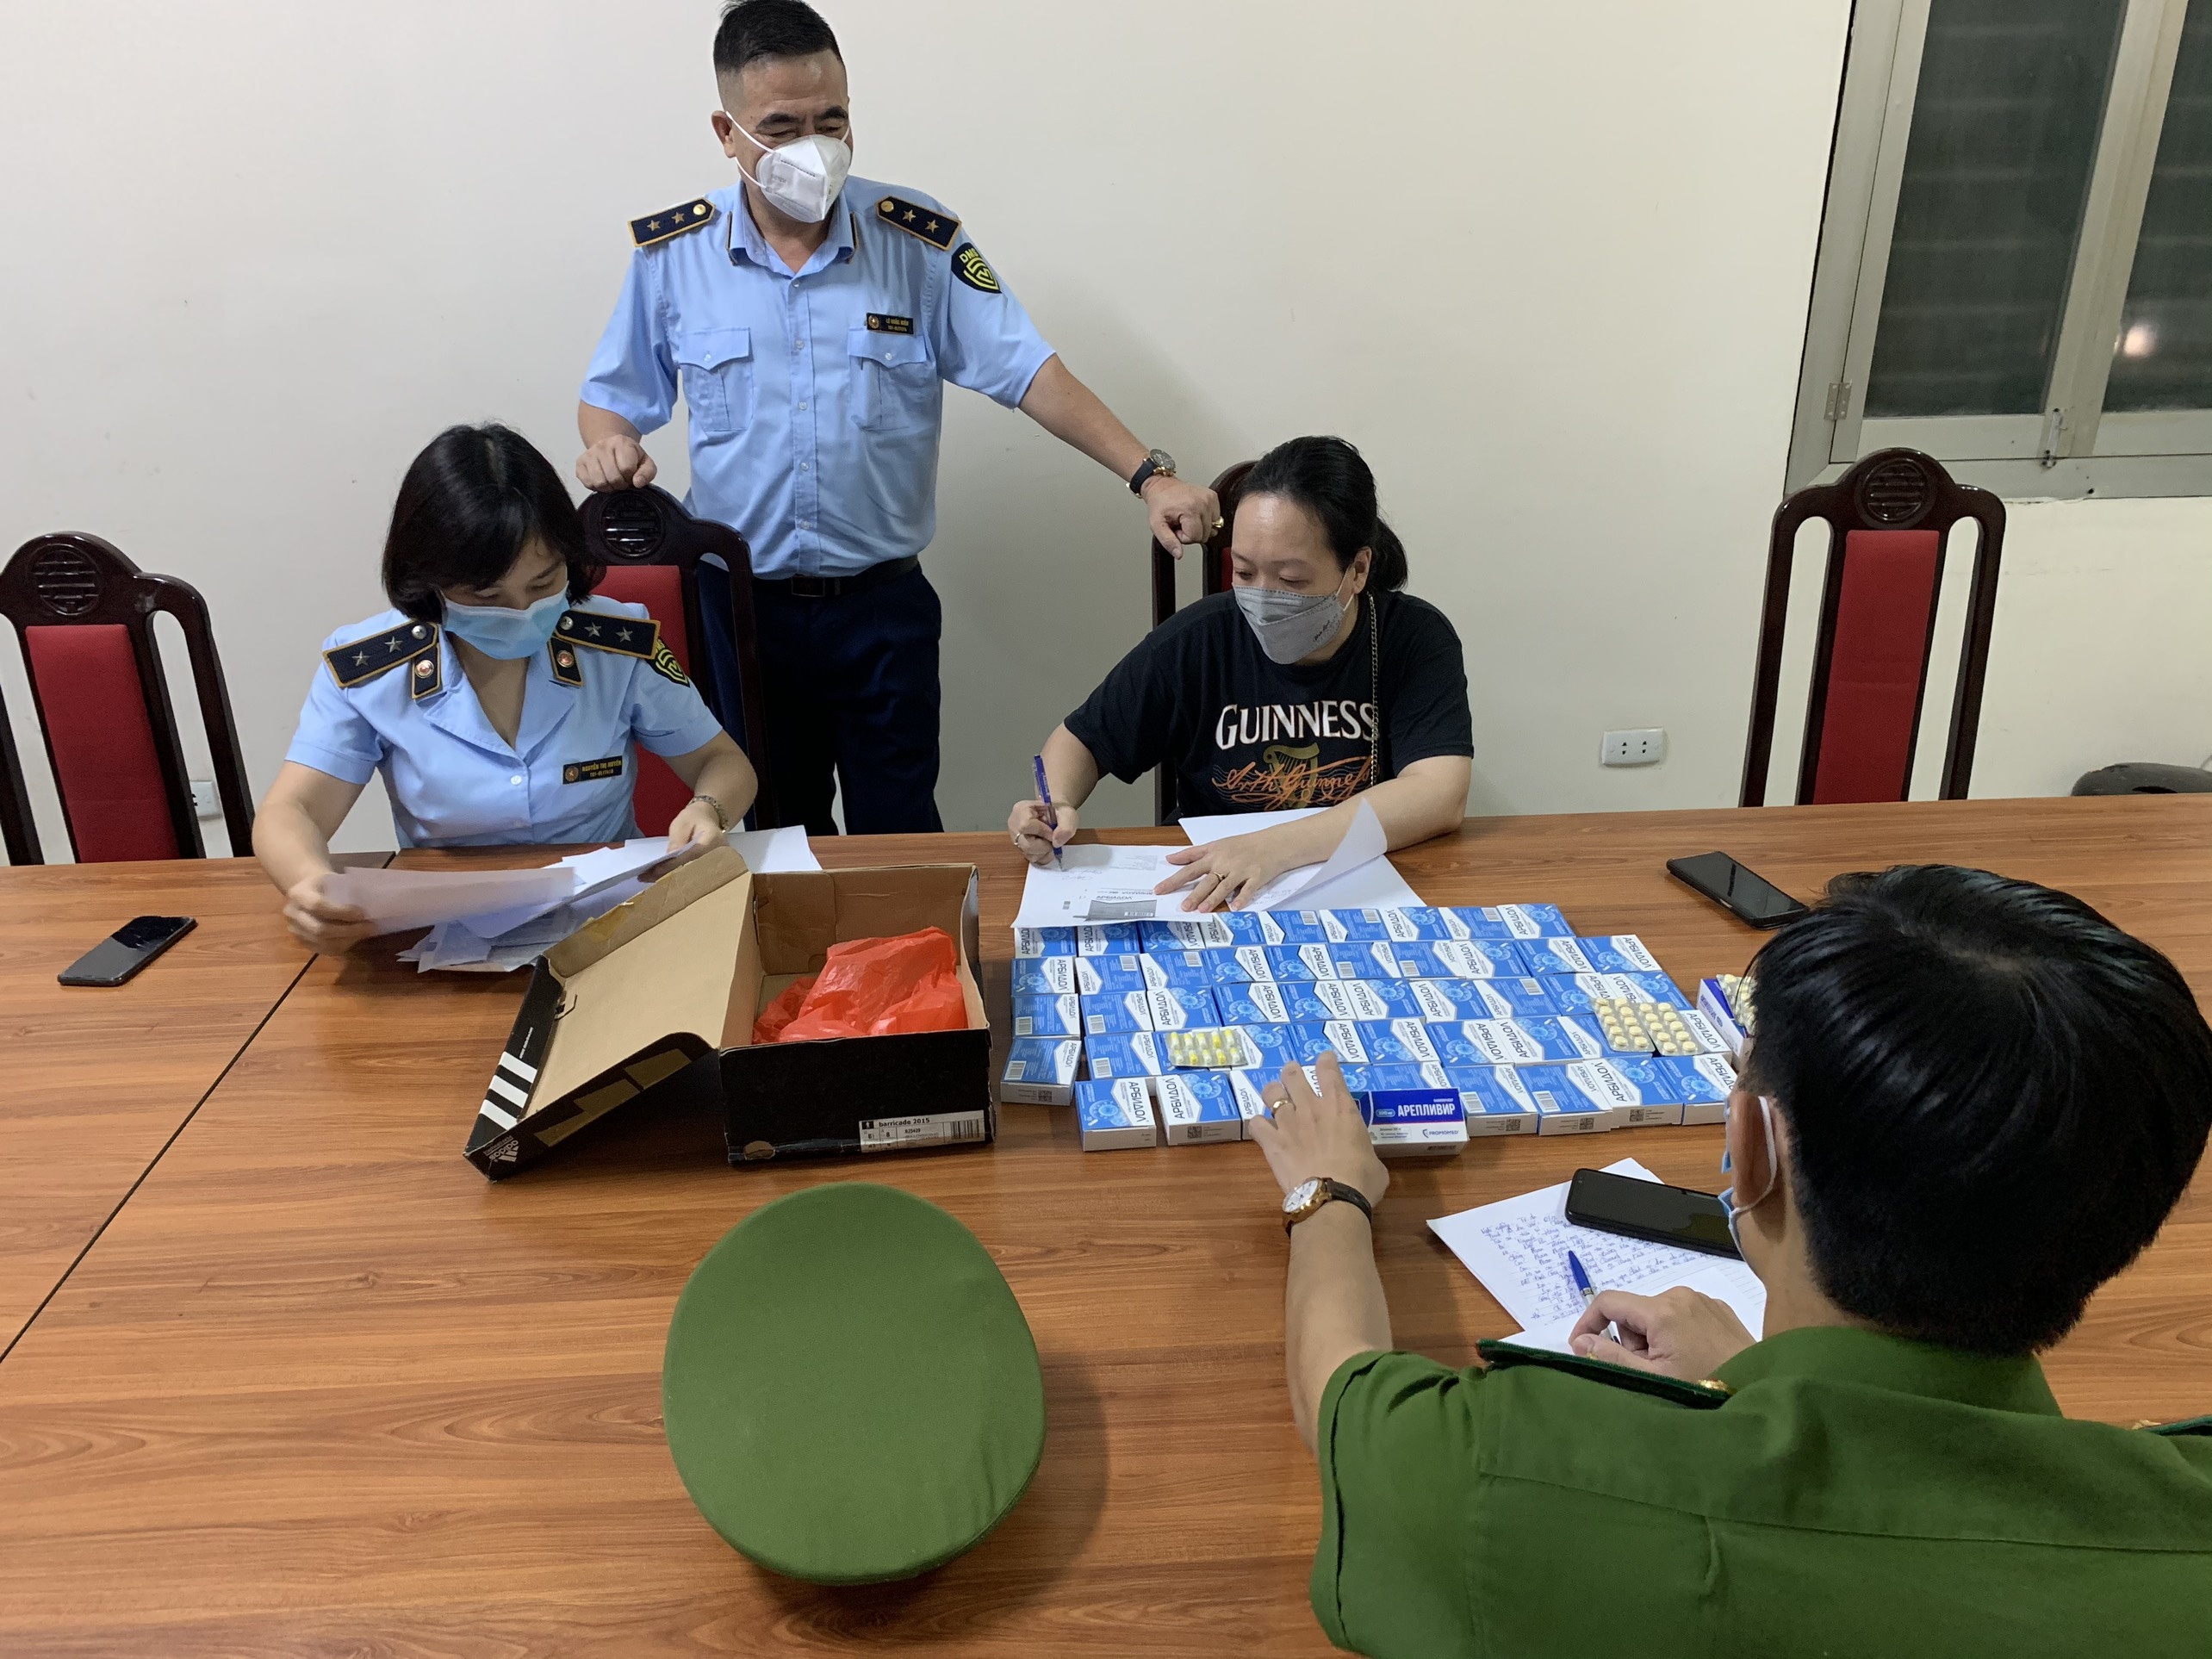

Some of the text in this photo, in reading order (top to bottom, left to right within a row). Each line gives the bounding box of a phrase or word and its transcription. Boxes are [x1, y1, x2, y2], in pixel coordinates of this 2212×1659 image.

[1215, 700, 1376, 750] GUINNESS
[1588, 975, 1611, 999] АРБИД
[1128, 1081, 1146, 1122] АРБИДОЛ
[1165, 1078, 1185, 1120] АРБИДОЛ
[1397, 1103, 1456, 1117] АРЕПЛИВИР
